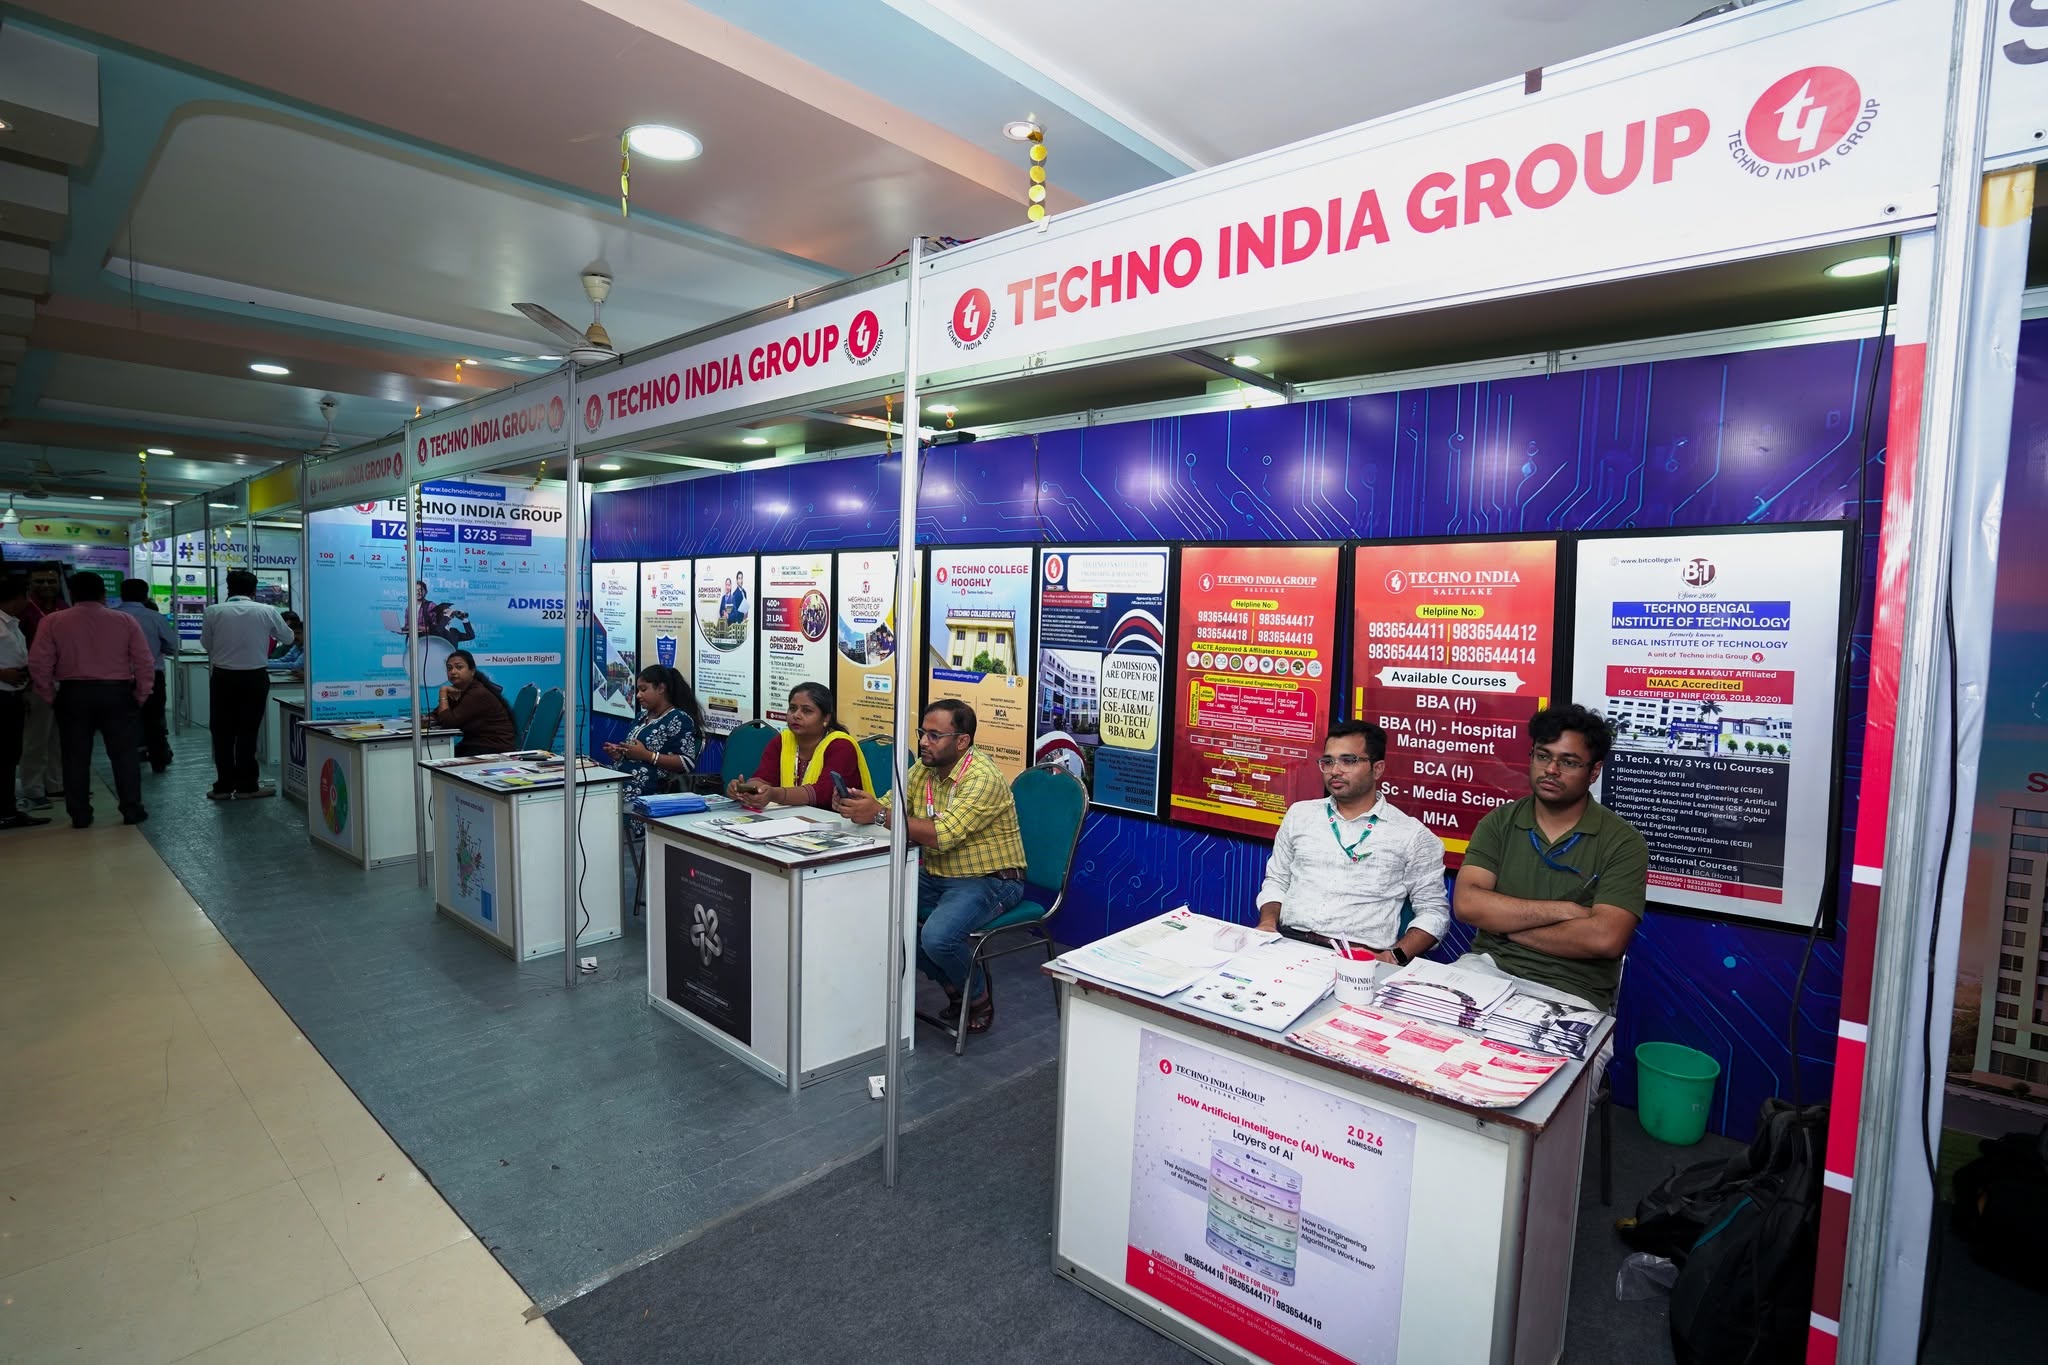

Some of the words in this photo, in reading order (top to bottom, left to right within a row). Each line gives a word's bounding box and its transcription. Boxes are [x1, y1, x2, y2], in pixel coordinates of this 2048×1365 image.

[1727, 129, 1770, 179] TECHNO
[1776, 157, 1830, 180] INDIA
[1836, 98, 1881, 157] GROUP
[1007, 237, 1203, 325] TECHNO
[1218, 188, 1390, 279] INDIA
[1406, 107, 1710, 233] GROUP
[946, 320, 962, 350] TECHNO
[962, 338, 983, 351] INDIA
[982, 309, 997, 340] GROUP
[607, 372, 680, 421] TECHNO
[685, 353, 743, 400] INDIA
[748, 324, 840, 382] GROUP
[429, 427, 468, 459] TECHNO
[471, 418, 500, 447] INDIA
[502, 406, 546, 438] GROUP
[386, 499, 456, 515] TEHNO
[461, 504, 505, 519] INDIA
[510, 509, 562, 522] GROUP
[464, 529, 496, 540] 3735
[198, 542, 260, 553] EUCATIN
[952, 565, 985, 574] TECHNO
[988, 565, 1029, 574] COLLEGE
[1408, 571, 1471, 584] TECHNO
[1476, 571, 1520, 583] INDIA
[951, 578, 991, 586] HOOGHLY
[1217, 575, 1254, 585] TECHNO
[1256, 576, 1282, 585] INDIA
[1283, 577, 1317, 585] GROUP
[1433, 588, 1493, 596] SALTLAKE
[508, 598, 589, 610] ADMISSN
[1236, 601, 1261, 609] Helpline
[1423, 607, 1458, 617] Helpline
[1461, 608, 1477, 616] No:
[1644, 603, 1697, 613] TECHNO
[1700, 603, 1754, 614] BENGAL
[1198, 611, 1249, 624] 9836544416
[1259, 614, 1314, 627] 9836544417
[1612, 617, 1674, 627] INSTITUTE
[1676, 617, 1694, 627] OF
[1696, 617, 1790, 628] TECHNOLOGY
[1197, 627, 1248, 640] 9836544418
[1258, 631, 1313, 644] 9836544419
[1369, 622, 1444, 639] 9836544411
[1452, 624, 1537, 641] 9836544412
[1215, 645, 1242, 653] Approved
[1612, 638, 1649, 647] BENGAL
[1650, 639, 1700, 648] INSTITUTE
[1701, 640, 1715, 648] OF
[1717, 640, 1788, 649] TECHNOLOGY
[492, 654, 525, 664] Navigate
[534, 654, 555, 663] Right!
[1369, 644, 1444, 662] 9836544413
[1452, 646, 1536, 665] 9836544414
[1111, 661, 1156, 672] ADMISSIONS
[1105, 671, 1119, 679] ARE
[1121, 672, 1141, 681] OPEN
[1142, 673, 1158, 682] FOR
[1391, 671, 1447, 684] Available
[1451, 674, 1507, 687] Courses
[1648, 679, 1679, 688] NAAC
[1681, 679, 1741, 691] Accredited
[1103, 687, 1154, 702] CSE/ECE/ME
[1103, 701, 1153, 717] CSE-AI&ML/
[1416, 694, 1450, 710] BBA
[1454, 697, 1477, 714] (H)
[995, 709, 1006, 717] MCA
[1104, 713, 1150, 728] BIO-TECH/
[1108, 725, 1145, 740] BBA/BCA
[1232, 734, 1261, 742] Management
[1397, 734, 1495, 754] Management
[1414, 761, 1447, 777] BCA
[1451, 765, 1474, 781] (H)
[1614, 754, 1624, 762] B.
[1626, 756, 1651, 764] Tech.
[1663, 759, 1683, 768] Yrs/
[1694, 761, 1711, 770] Yrs
[1714, 762, 1726, 771] (L)
[1729, 763, 1774, 775] Courses
[1423, 811, 1459, 828] MHA
[1649, 853, 1697, 866] rofessional
[1699, 859, 1738, 872] Courses
[1175, 1063, 1209, 1084] TECHNO
[1210, 1075, 1234, 1093] INDIA
[1235, 1086, 1266, 1104] GROUP
[1177, 1093, 1200, 1108] HOW
[1200, 1102, 1240, 1125] Artificial
[1241, 1116, 1299, 1148] Intelligence
[1300, 1139, 1320, 1157] (AI)
[1322, 1150, 1356, 1170] Works
[1347, 1125, 1384, 1148] 2026
[1232, 1128, 1267, 1152] Layers
[1268, 1144, 1280, 1156] of
[1282, 1146, 1294, 1161] AI
[1346, 1138, 1383, 1157] ADMISSION
[1301, 1226, 1348, 1252] Mathematical
[1302, 1217, 1316, 1229] How
[1317, 1223, 1327, 1232] Do
[1327, 1227, 1368, 1252] Engineering
[1301, 1233, 1336, 1256] Algorithms
[1337, 1248, 1354, 1263] Work
[1355, 1254, 1376, 1271] Here?
[1222, 1263, 1249, 1282] HELPLINES
[1250, 1276, 1261, 1288] FOR
[1262, 1282, 1279, 1297] QUERY
[1184, 1253, 1224, 1281] 9836544416
[1228, 1276, 1271, 1304] 9836544417
[1276, 1300, 1322, 1330] 9836544418
